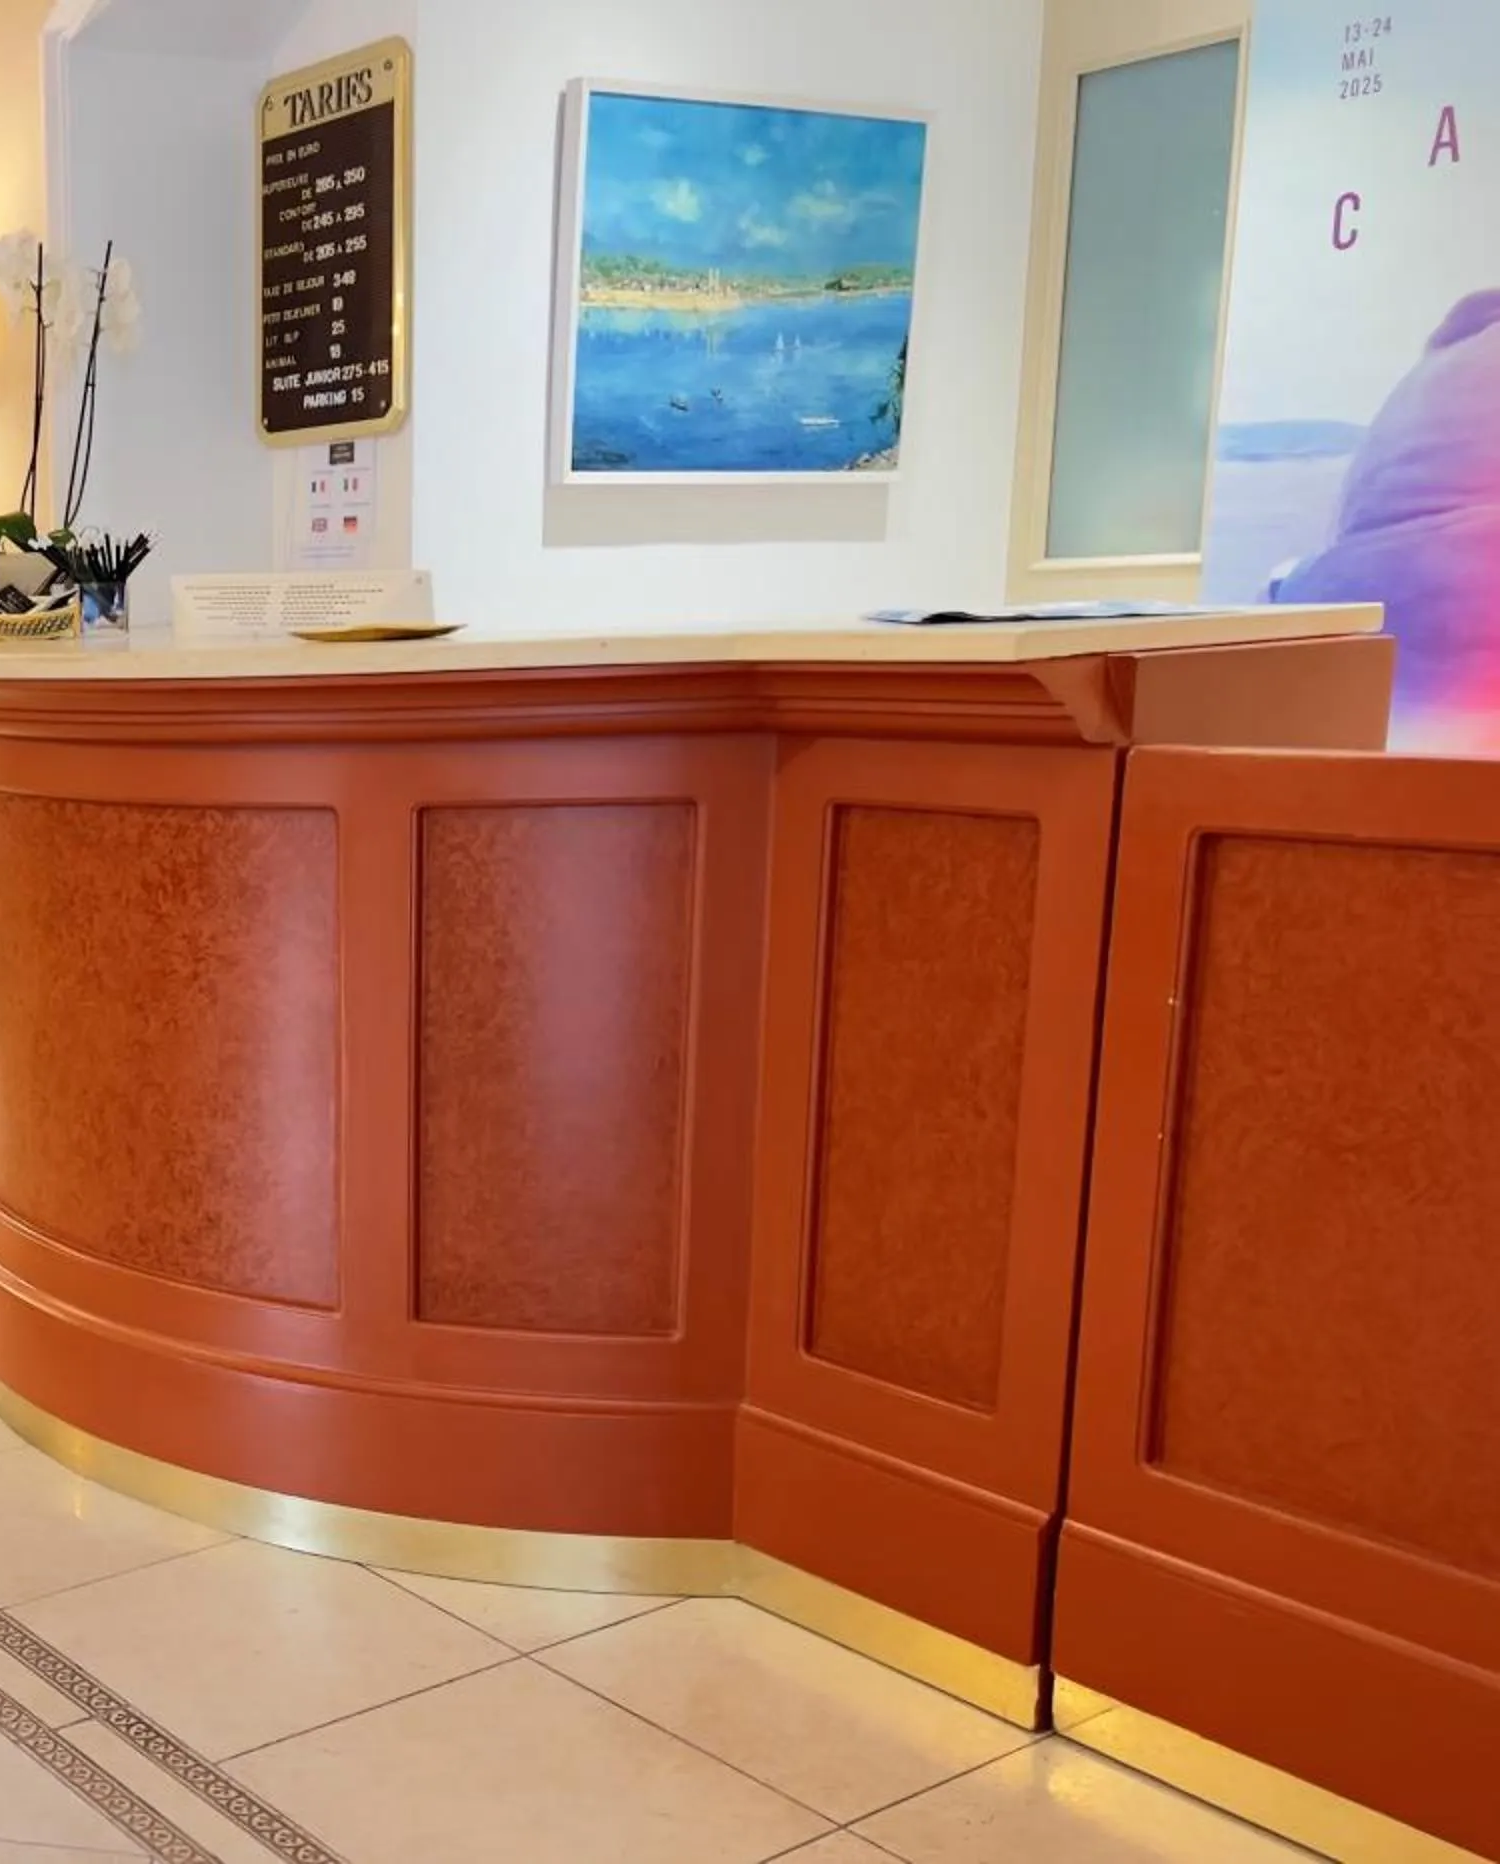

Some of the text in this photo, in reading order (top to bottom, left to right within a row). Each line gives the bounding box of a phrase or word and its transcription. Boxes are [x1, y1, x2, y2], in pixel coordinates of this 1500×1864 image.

[1341, 48, 1375, 71] MAI
[283, 68, 373, 128] TARIFS
[1338, 74, 1382, 99] 2025
[301, 187, 312, 200] DE
[344, 166, 365, 185] 350
[1332, 105, 1460, 250] C A
[301, 219, 312, 232] DE
[313, 211, 334, 230] 245
[344, 202, 365, 221] 295
[345, 235, 367, 253] 255
[331, 319, 344, 335] 25
[273, 373, 300, 391] SUITE
[303, 386, 364, 409] PARKING 15
